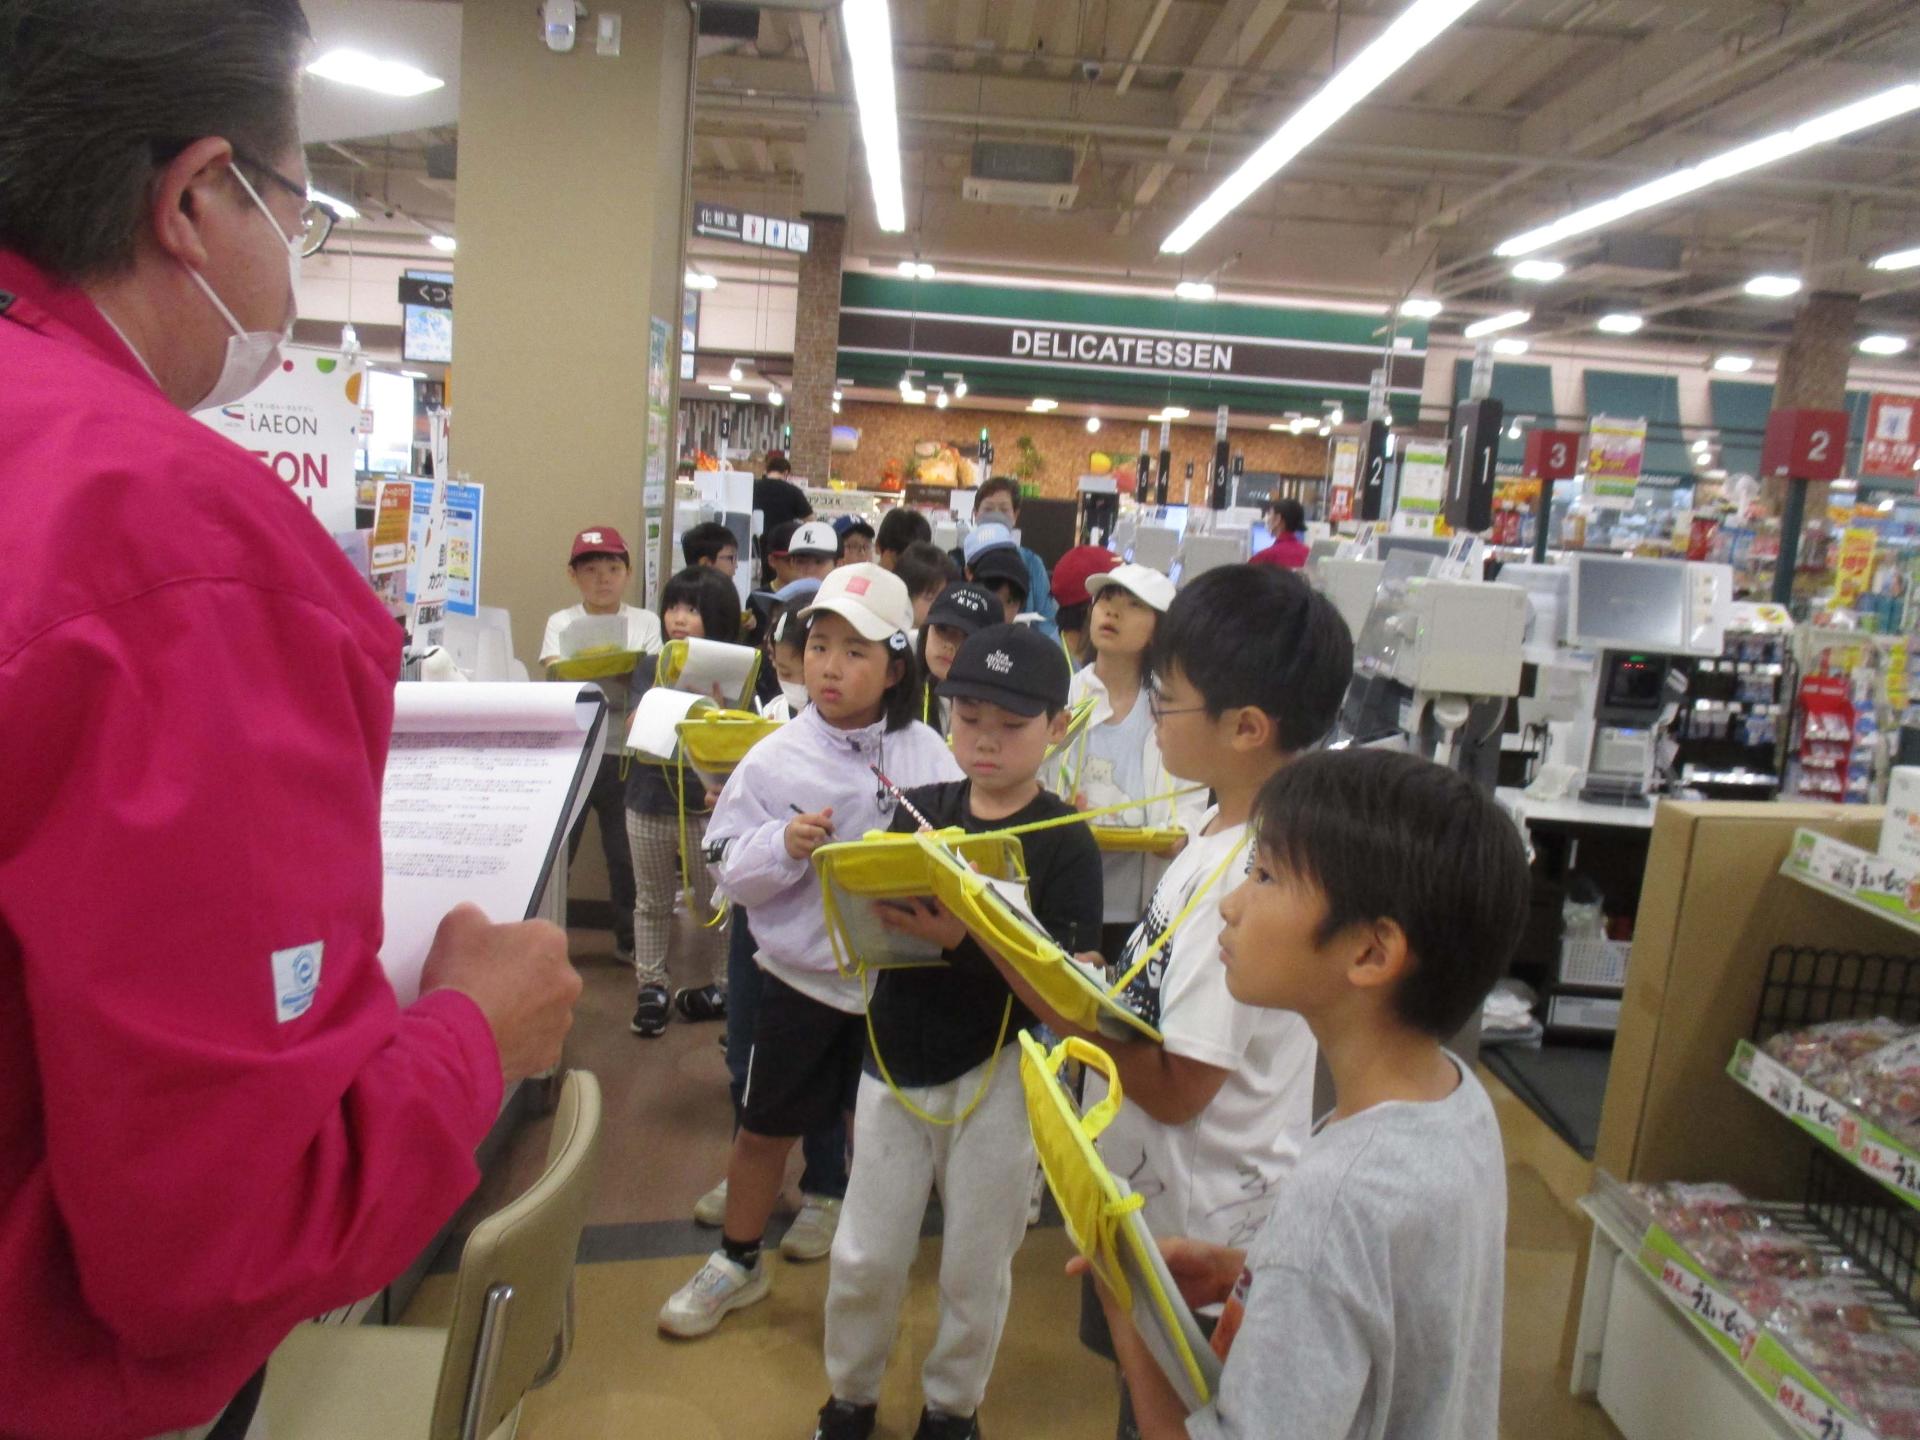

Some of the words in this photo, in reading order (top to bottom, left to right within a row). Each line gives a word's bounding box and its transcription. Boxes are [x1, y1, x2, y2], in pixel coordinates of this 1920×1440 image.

[419, 284, 453, 302] くつ
[1011, 329, 1233, 371] DELICATESSEN
[250, 413, 318, 436] iAEON
[1550, 442, 1568, 469] 3
[1808, 430, 1831, 461] 2
[1217, 464, 1226, 488] 3
[1370, 456, 1383, 486] 2
[1481, 446, 1491, 485] 1
